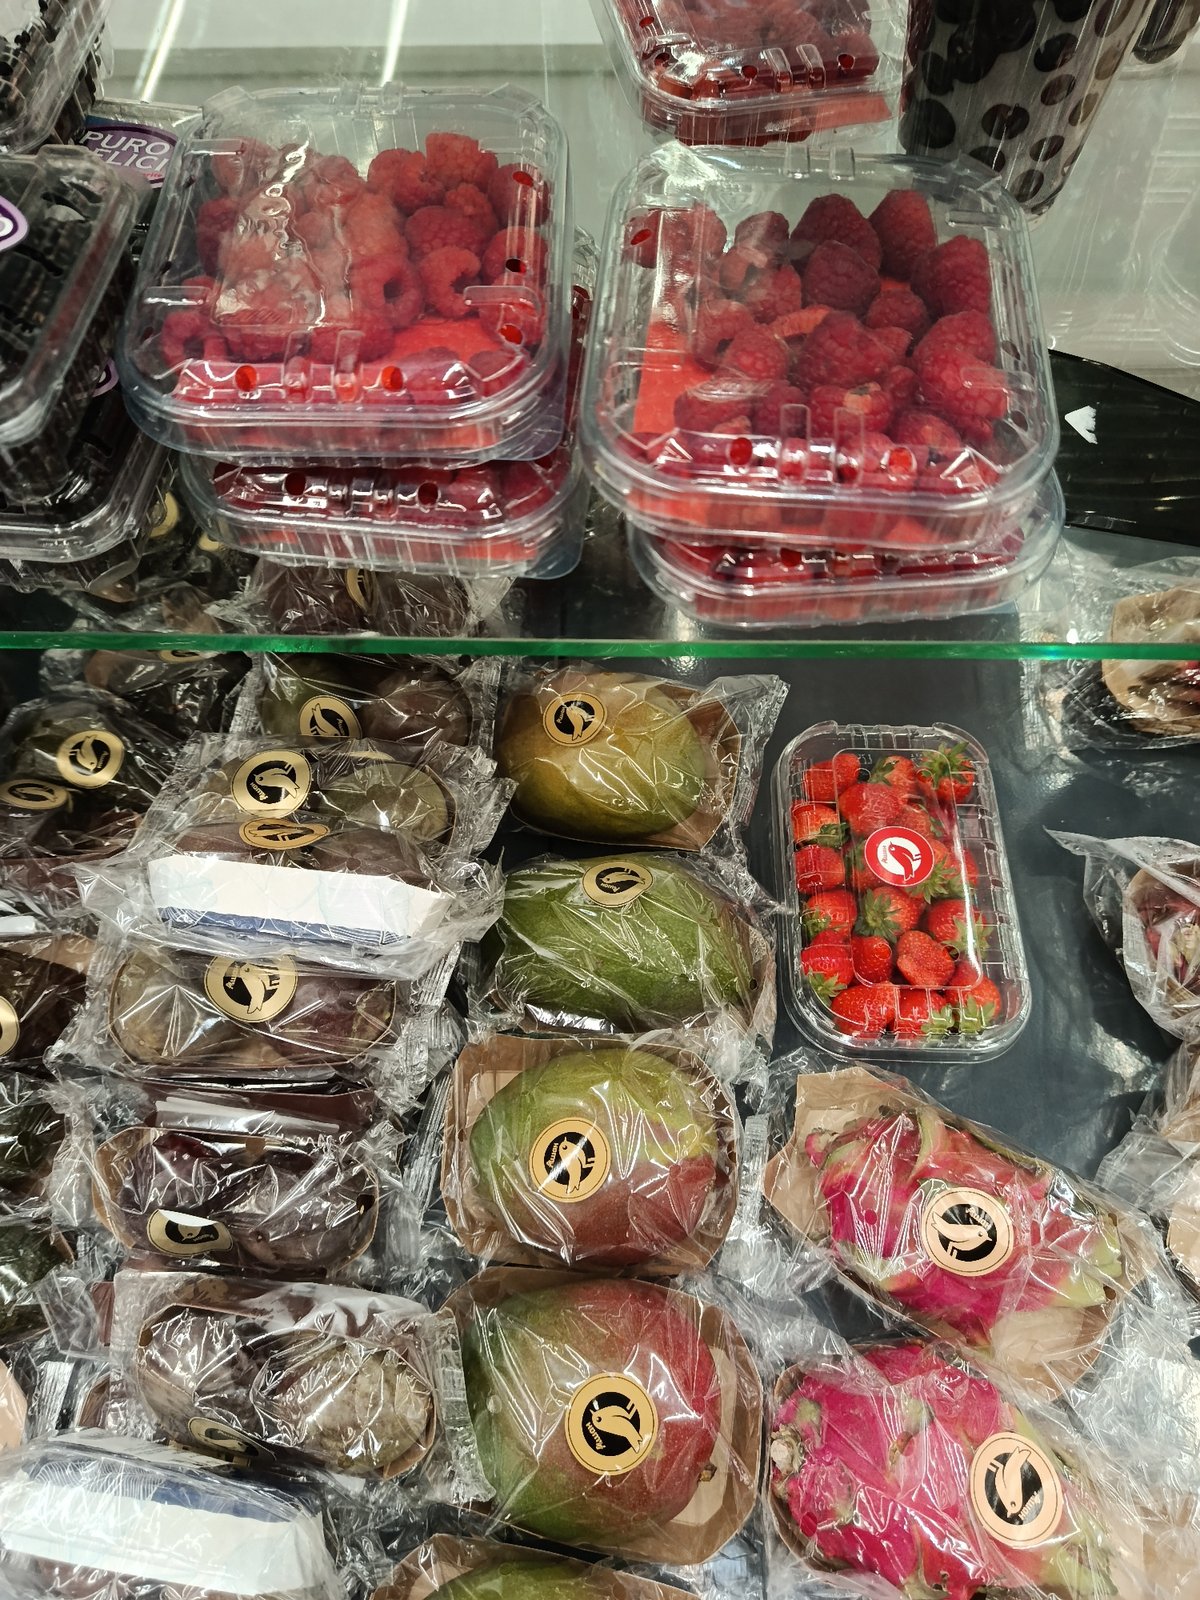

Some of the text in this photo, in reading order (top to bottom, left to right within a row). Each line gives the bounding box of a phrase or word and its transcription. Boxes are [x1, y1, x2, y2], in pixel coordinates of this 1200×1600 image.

[79, 130, 170, 155] PURO
[545, 1142, 560, 1169] Ашан
[585, 1421, 607, 1451] Ашан
